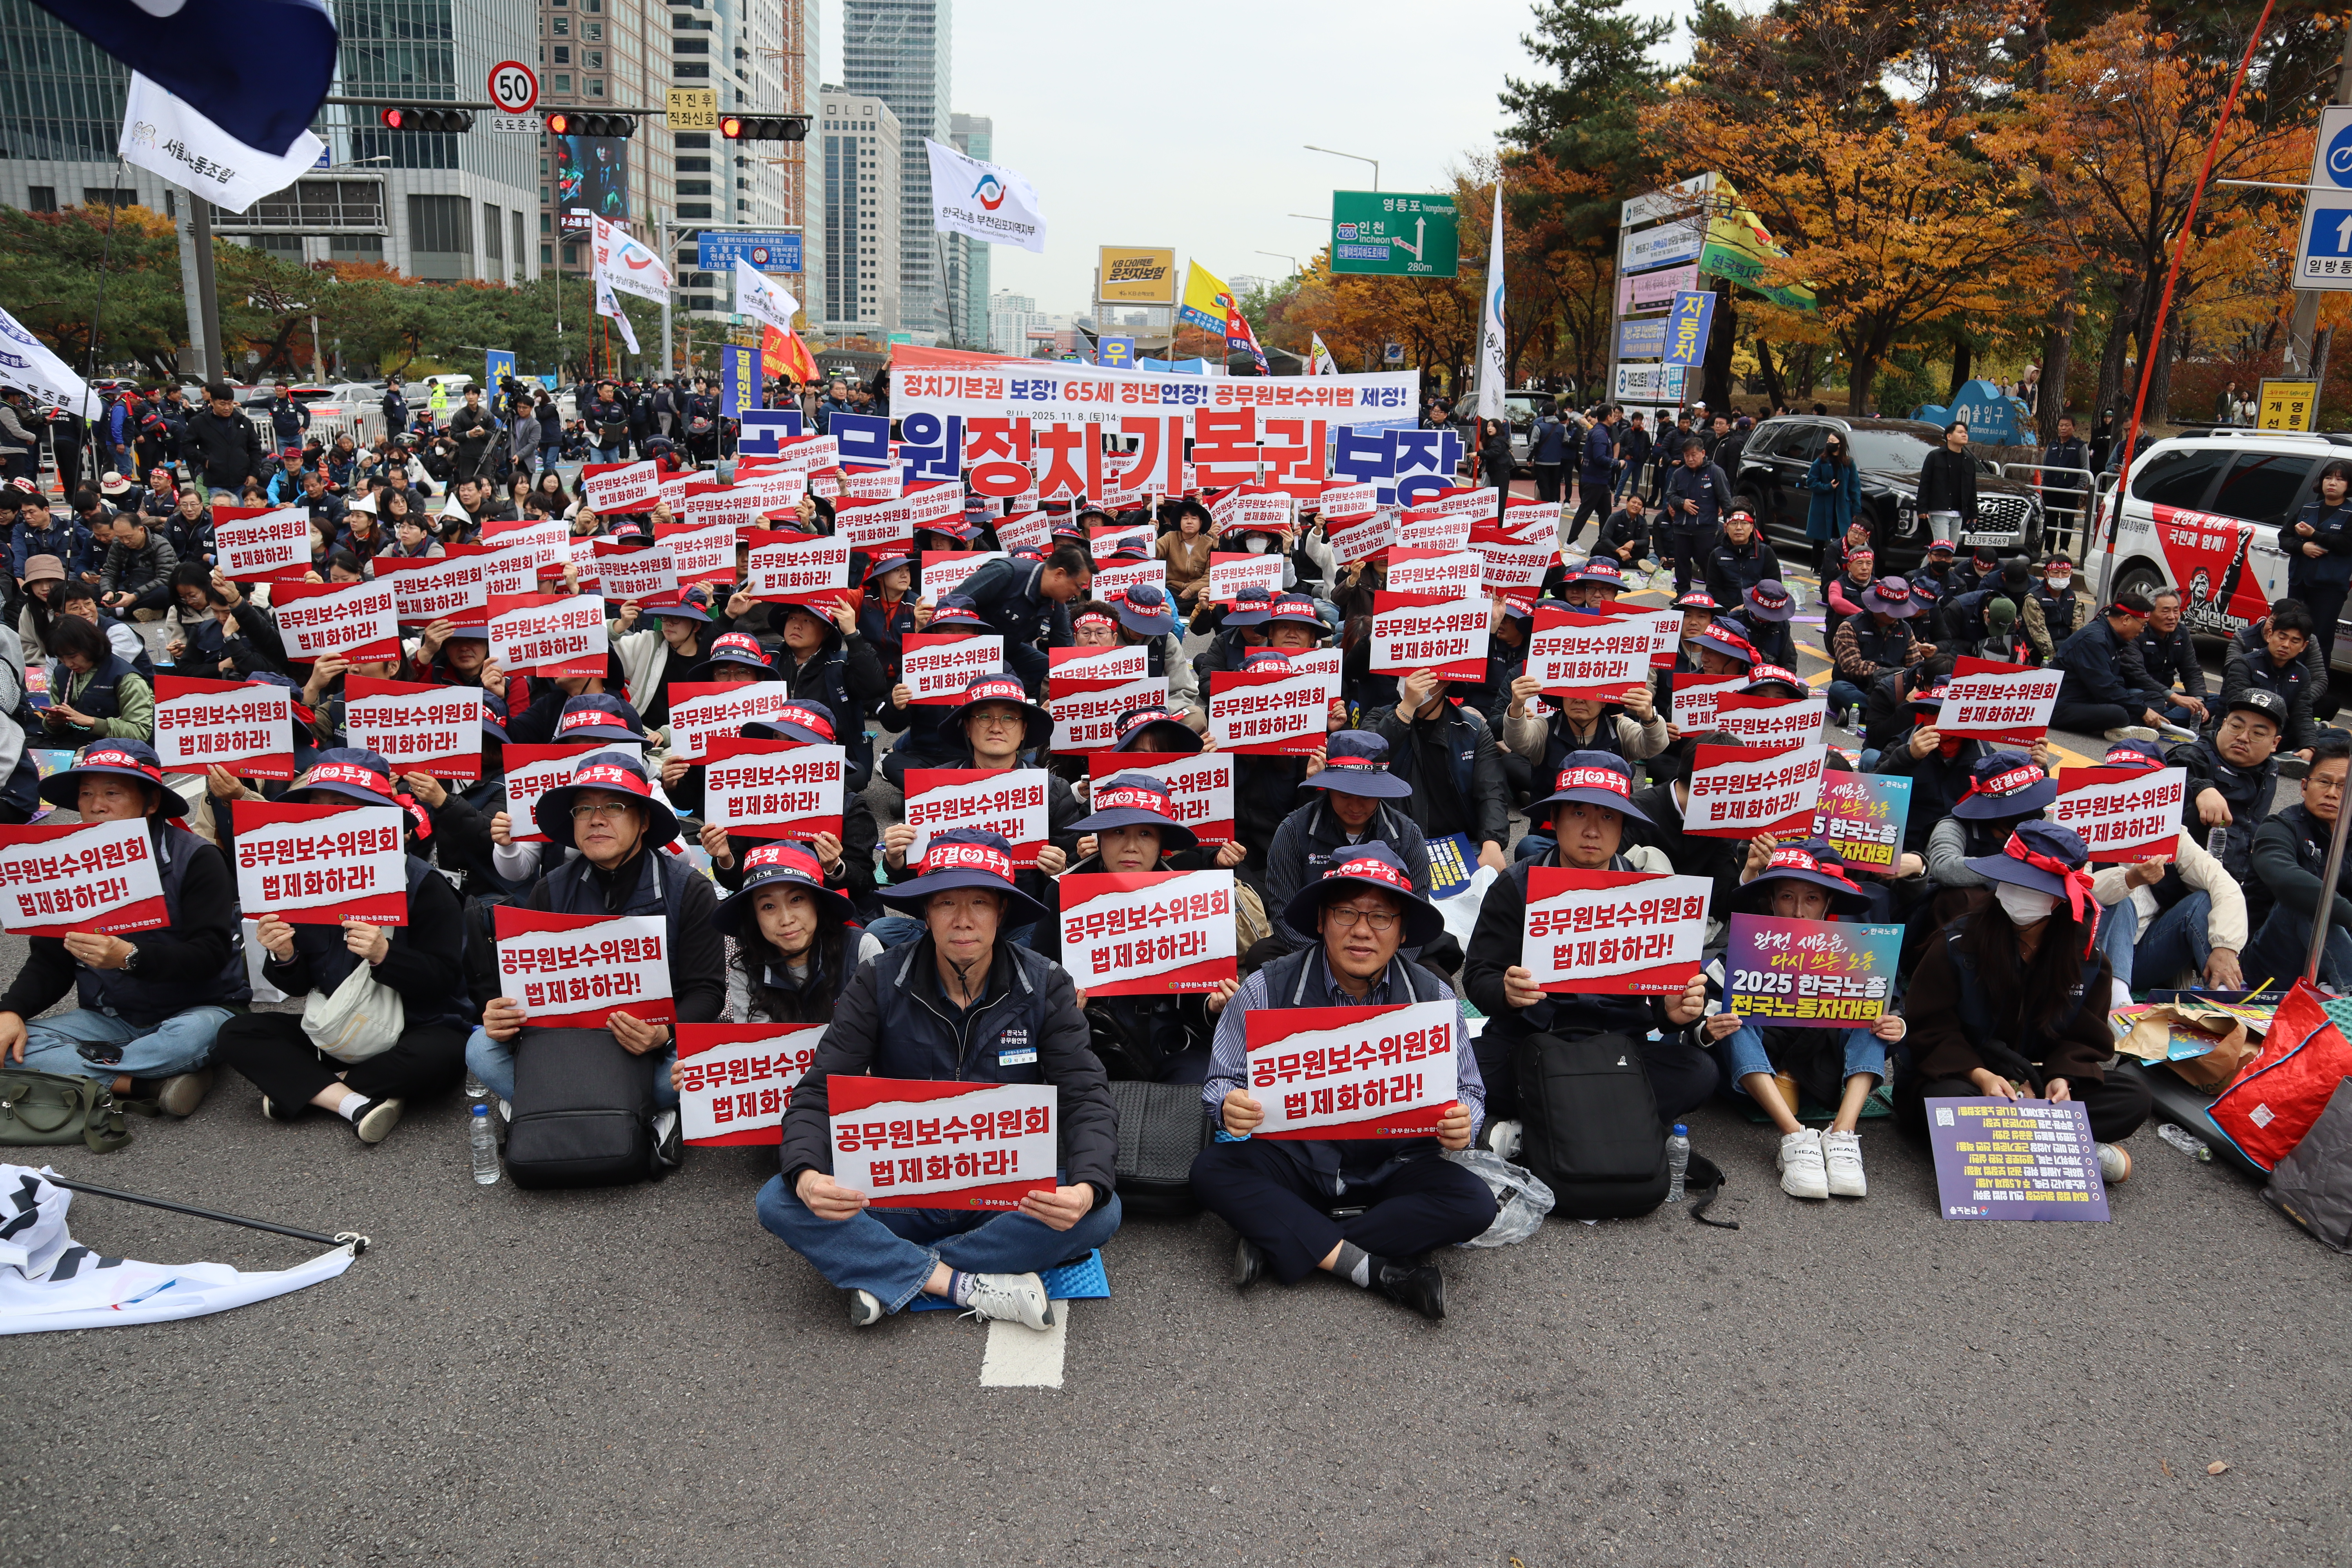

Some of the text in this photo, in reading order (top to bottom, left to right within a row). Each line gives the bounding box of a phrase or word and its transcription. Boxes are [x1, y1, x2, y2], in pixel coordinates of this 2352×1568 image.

[500, 75, 528, 101] 50
[494, 119, 539, 131] 속도준수
[670, 112, 715, 126] 직좌신호
[1383, 198, 1457, 214] 영등포 Yeongdeungpo
[1633, 204, 1644, 217] 영등포구
[943, 207, 1035, 236] 한국노총 부천김포지역지부
[1359, 221, 1385, 235] 인천
[1341, 229, 1390, 244] 120 Incheon
[1124, 258, 1154, 267] 다이렉트
[1408, 262, 1432, 271] 280m
[1109, 267, 1169, 280] 운전자보험
[1672, 296, 1704, 362] 자동차
[1104, 343, 1127, 365] 우
[904, 376, 1406, 407] 정치기본권 보장! 65세 정년연장! 공무원보수위법 제정!
[1033, 411, 1057, 420] 2025.
[1973, 405, 2003, 424] 출입구
[1970, 425, 1989, 434] Entrance
[967, 408, 1326, 499] 정치기본권
[1334, 426, 1465, 508] 보장
[587, 469, 655, 493] 공무원보수위원회
[599, 486, 647, 506] 법제화하라!
[1238, 499, 1289, 509] 공무원보수위원회
[1322, 489, 1375, 503] 공무원보수위원회
[1244, 512, 1283, 521] 법제화하라!
[1329, 501, 1367, 513] 법제화하라!
[2172, 511, 2232, 531] 현장과 함께!
[217, 520, 307, 549] 공무원보수위원회
[1988, 537, 2007, 545] 5469
[2169, 529, 2226, 552] 국민과 함께!
[231, 548, 293, 569] 법제화하라!
[751, 548, 846, 570] 공무원보수위원회
[765, 571, 831, 589] 법제화하라!
[1276, 602, 1314, 614] 단결 투쟁
[2194, 608, 2249, 629] 건설연맹
[491, 608, 602, 643] 공무원보수위원회
[1375, 612, 1487, 638] 공무원보수위원회
[508, 636, 587, 663] 법제화하라!
[1391, 637, 1468, 661] 법제화하라!
[1532, 636, 1649, 656] 공무원보수위원회
[1547, 661, 1628, 681] 법제화하라!
[1949, 682, 2057, 702] 공무원보수위원회
[158, 701, 287, 730] 공무원보수위원회
[1958, 706, 2035, 723] 법제화하라!
[179, 730, 271, 755] 법제화하라!
[249, 768, 289, 778] 공무원노동조합연맹
[1561, 769, 1627, 792] 단결 투쟁
[1692, 759, 1822, 796] 공무원보수위원회
[1886, 780, 1907, 789] 한국노총
[1096, 792, 1161, 812] 단결 투쟁
[1710, 791, 1800, 821] 법제화하라!
[2058, 782, 2182, 821] 공무원보수위원회
[1829, 818, 1898, 844] 한국노총
[239, 826, 399, 868] 공무원보수위원회
[929, 848, 1009, 877] 단결 투쟁
[263, 866, 375, 901] 법제화하라!
[755, 869, 772, 878] F-14
[17, 877, 127, 917] 법제화하라!
[107, 918, 162, 932] 공무원노동조합연맹
[349, 913, 400, 922] 공무원노동조합연맹
[1064, 889, 1229, 944] 공무원보수위원회
[1528, 896, 1704, 937] 공무원보수위원회
[1092, 931, 1206, 974] 법제화하라!
[1553, 933, 1673, 971] 법제화하라!
[1754, 931, 1848, 953] 완전 새로운,
[501, 936, 662, 975] 공무원보수위원회
[1771, 951, 1876, 971] 다시 쓰는 노동
[525, 973, 641, 1007] 법제화하라!
[1732, 969, 1887, 998] 2025 한국노총
[1731, 995, 1884, 1020] 전국노동자대회
[1252, 1023, 1450, 1088] 공무원보수위원회
[1285, 1074, 1423, 1120] 법제화하라!
[836, 1106, 1049, 1152] 공무원보수위원회
[1794, 1148, 1822, 1157] HEAD
[1969, 1154, 2081, 1165] 기후위기 극복, 정의로운 전환 실현!
[870, 1149, 1018, 1187] 법제화하라!
[1964, 1166, 2084, 1177] 일하는 사람을 위한 권리 보장법 제정!
[1976, 1178, 2086, 1189] 실노동시간 단축, 주 4.5일제 시행!
[1973, 1191, 2089, 1201] 65세 법정 정년연장 연내 입법 쟁취!
[1950, 1207, 1978, 1215] 한국노총
[2283, 1203, 2307, 1225] emart.com
